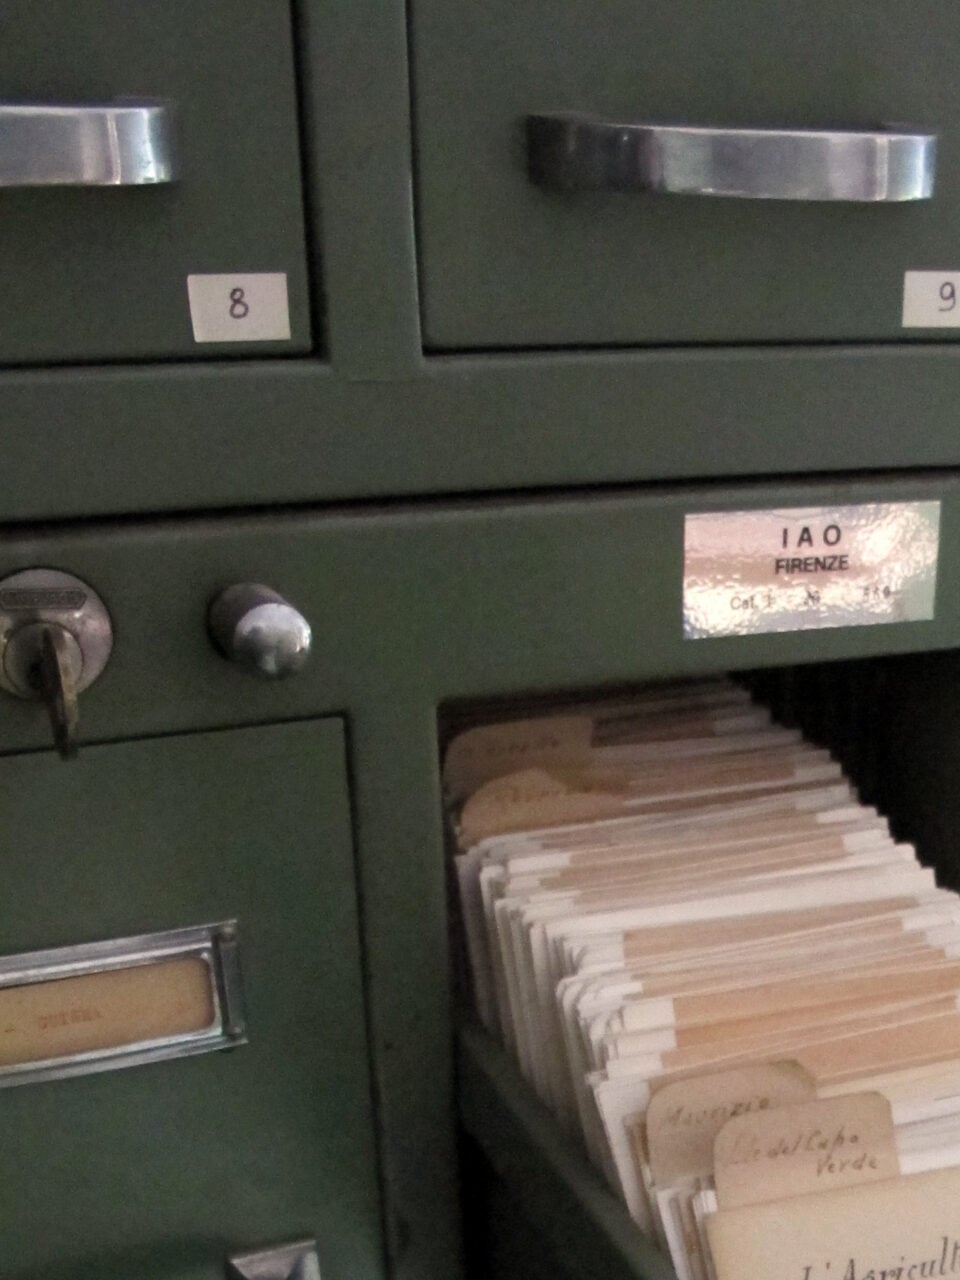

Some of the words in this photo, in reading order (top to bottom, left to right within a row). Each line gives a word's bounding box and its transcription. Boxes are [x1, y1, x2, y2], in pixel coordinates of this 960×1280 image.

[228, 287, 249, 319] 8
[937, 281, 956, 312] 9
[774, 554, 850, 575] FIRENZE
